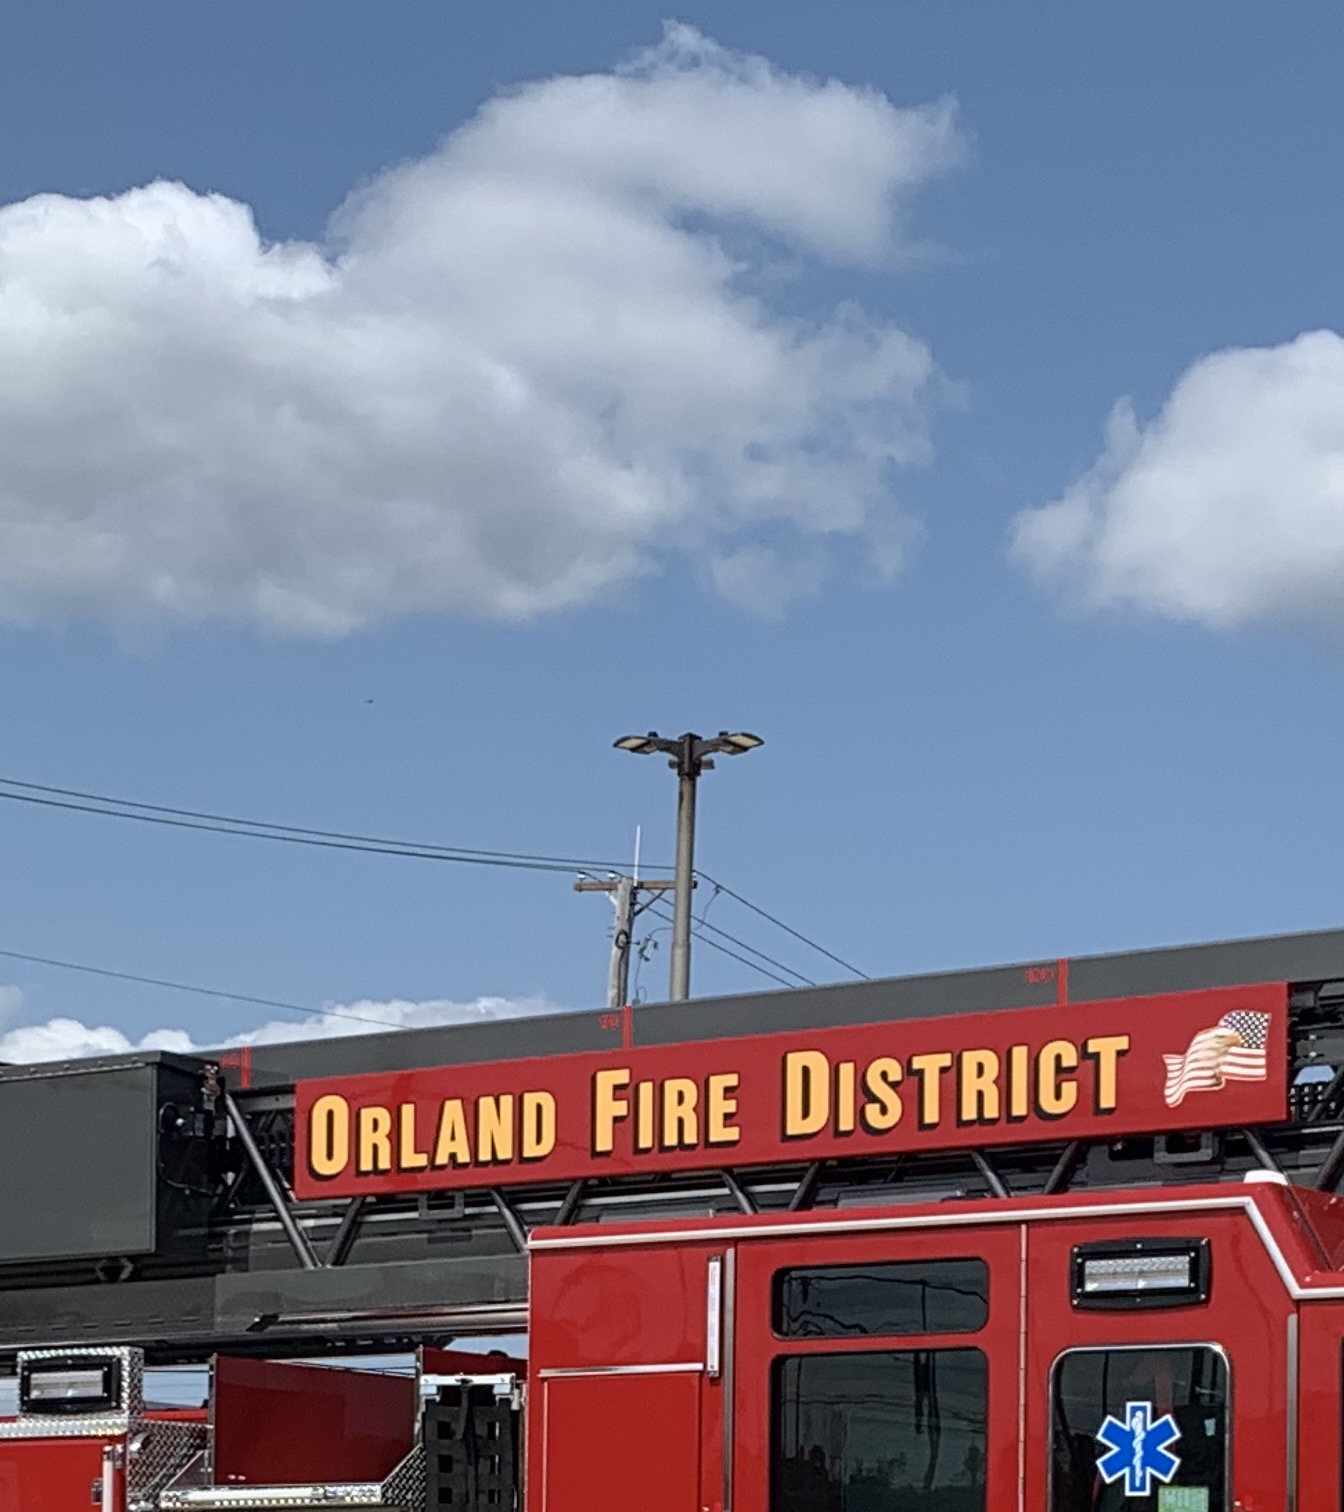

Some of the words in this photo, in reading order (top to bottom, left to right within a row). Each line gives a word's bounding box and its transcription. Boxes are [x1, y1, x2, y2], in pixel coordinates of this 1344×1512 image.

[310, 1091, 557, 1177] ORLAND
[592, 1068, 741, 1155] FIRE
[784, 1035, 1130, 1138] DISTRICT
